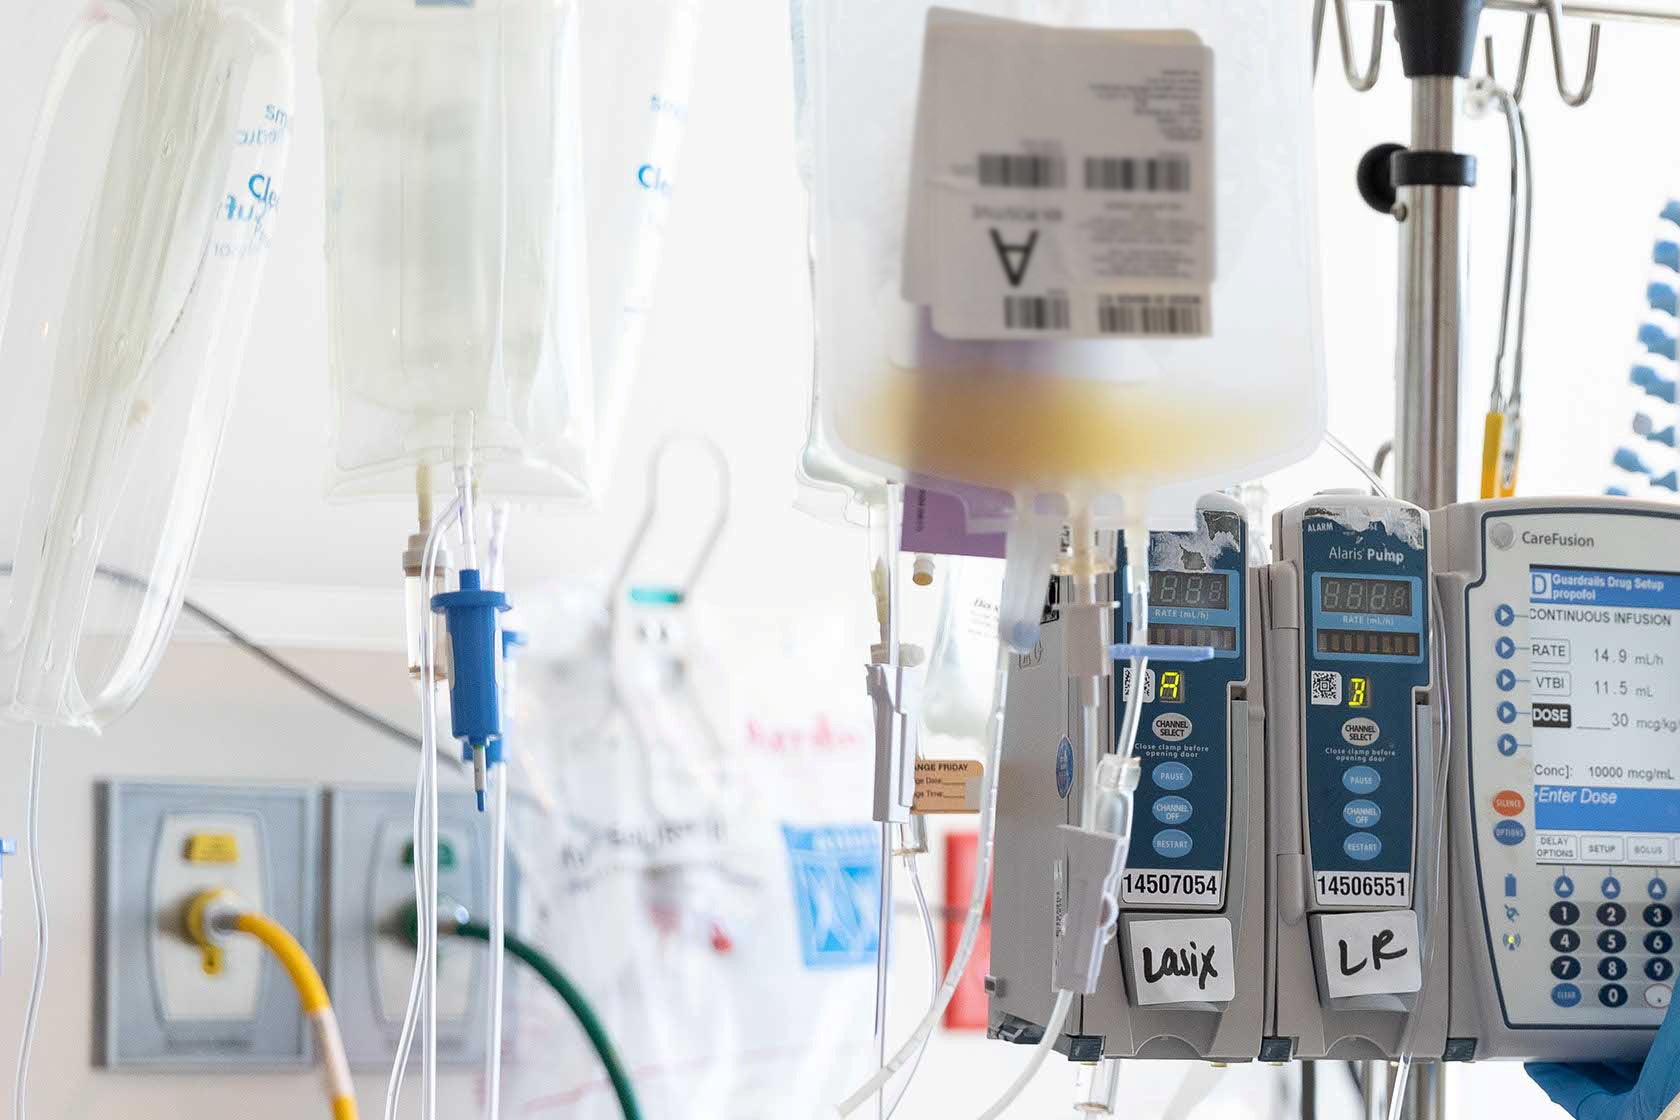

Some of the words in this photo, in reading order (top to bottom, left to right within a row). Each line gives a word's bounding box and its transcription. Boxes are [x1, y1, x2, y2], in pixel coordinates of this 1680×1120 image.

[989, 228, 1039, 288] A
[1307, 523, 1333, 532] ALARM
[1521, 531, 1595, 547] CareFusion
[1328, 547, 1363, 560] Alaris
[1367, 549, 1404, 564] Pump
[1531, 574, 1547, 595] D
[1552, 573, 1605, 588] Guardrails
[1607, 576, 1632, 591] Drug
[1635, 577, 1664, 592] Setup
[1552, 589, 1596, 601] propofol
[1155, 609, 1177, 618] RATE
[1343, 615, 1364, 624] RATE
[1530, 608, 1610, 624] CONTINUOUS
[1614, 612, 1672, 626] INFUSION
[1532, 644, 1566, 657] RATE
[1594, 649, 1628, 663] 14.9
[1635, 654, 1664, 666] mL/h
[1159, 671, 1180, 699] A
[1536, 677, 1565, 689] VTBI
[1594, 681, 1628, 696] 11.5
[1636, 687, 1654, 698] mL
[1532, 708, 1569, 722] DOSE
[1156, 720, 1188, 728] CHANNEL
[1345, 724, 1376, 733] CHANNEL
[1160, 728, 1185, 737] SELECT
[1349, 733, 1373, 741] SELECT
[1145, 750, 1178, 758] opening
[1180, 750, 1199, 758] door
[1158, 743, 1181, 752] clamp
[1184, 744, 1209, 752] before
[1347, 748, 1369, 757] clamp
[1336, 755, 1367, 763] opening
[938, 763, 968, 771] FRIDAY
[1589, 766, 1623, 778] 10000
[1627, 768, 1674, 781] mcg/mL
[1350, 777, 1373, 785] PAUSE
[1580, 788, 1617, 804] Dose
[1156, 804, 1188, 812] CHANNEL
[1346, 808, 1378, 816] CHANNEL
[1355, 816, 1369, 824] OFF
[1156, 840, 1188, 848] RESTART
[1347, 843, 1377, 851] RESTART
[1540, 837, 1568, 846] DELAY
[1537, 849, 1574, 858] OPTIONS
[1589, 844, 1616, 853] SETUP
[1123, 874, 1217, 895] 14507054
[1317, 876, 1405, 896] 14506551
[1561, 907, 1568, 920] 1
[1607, 907, 1616, 921] 2
[1653, 908, 1662, 922] 3
[1560, 934, 1570, 947] 4
[1607, 935, 1616, 948] 5
[1653, 935, 1663, 950] 6
[1142, 941, 1218, 990] Lasix
[1561, 961, 1570, 975] 7
[1608, 962, 1617, 976] 8
[1653, 962, 1664, 976] 9
[1608, 989, 1618, 1002] 0
